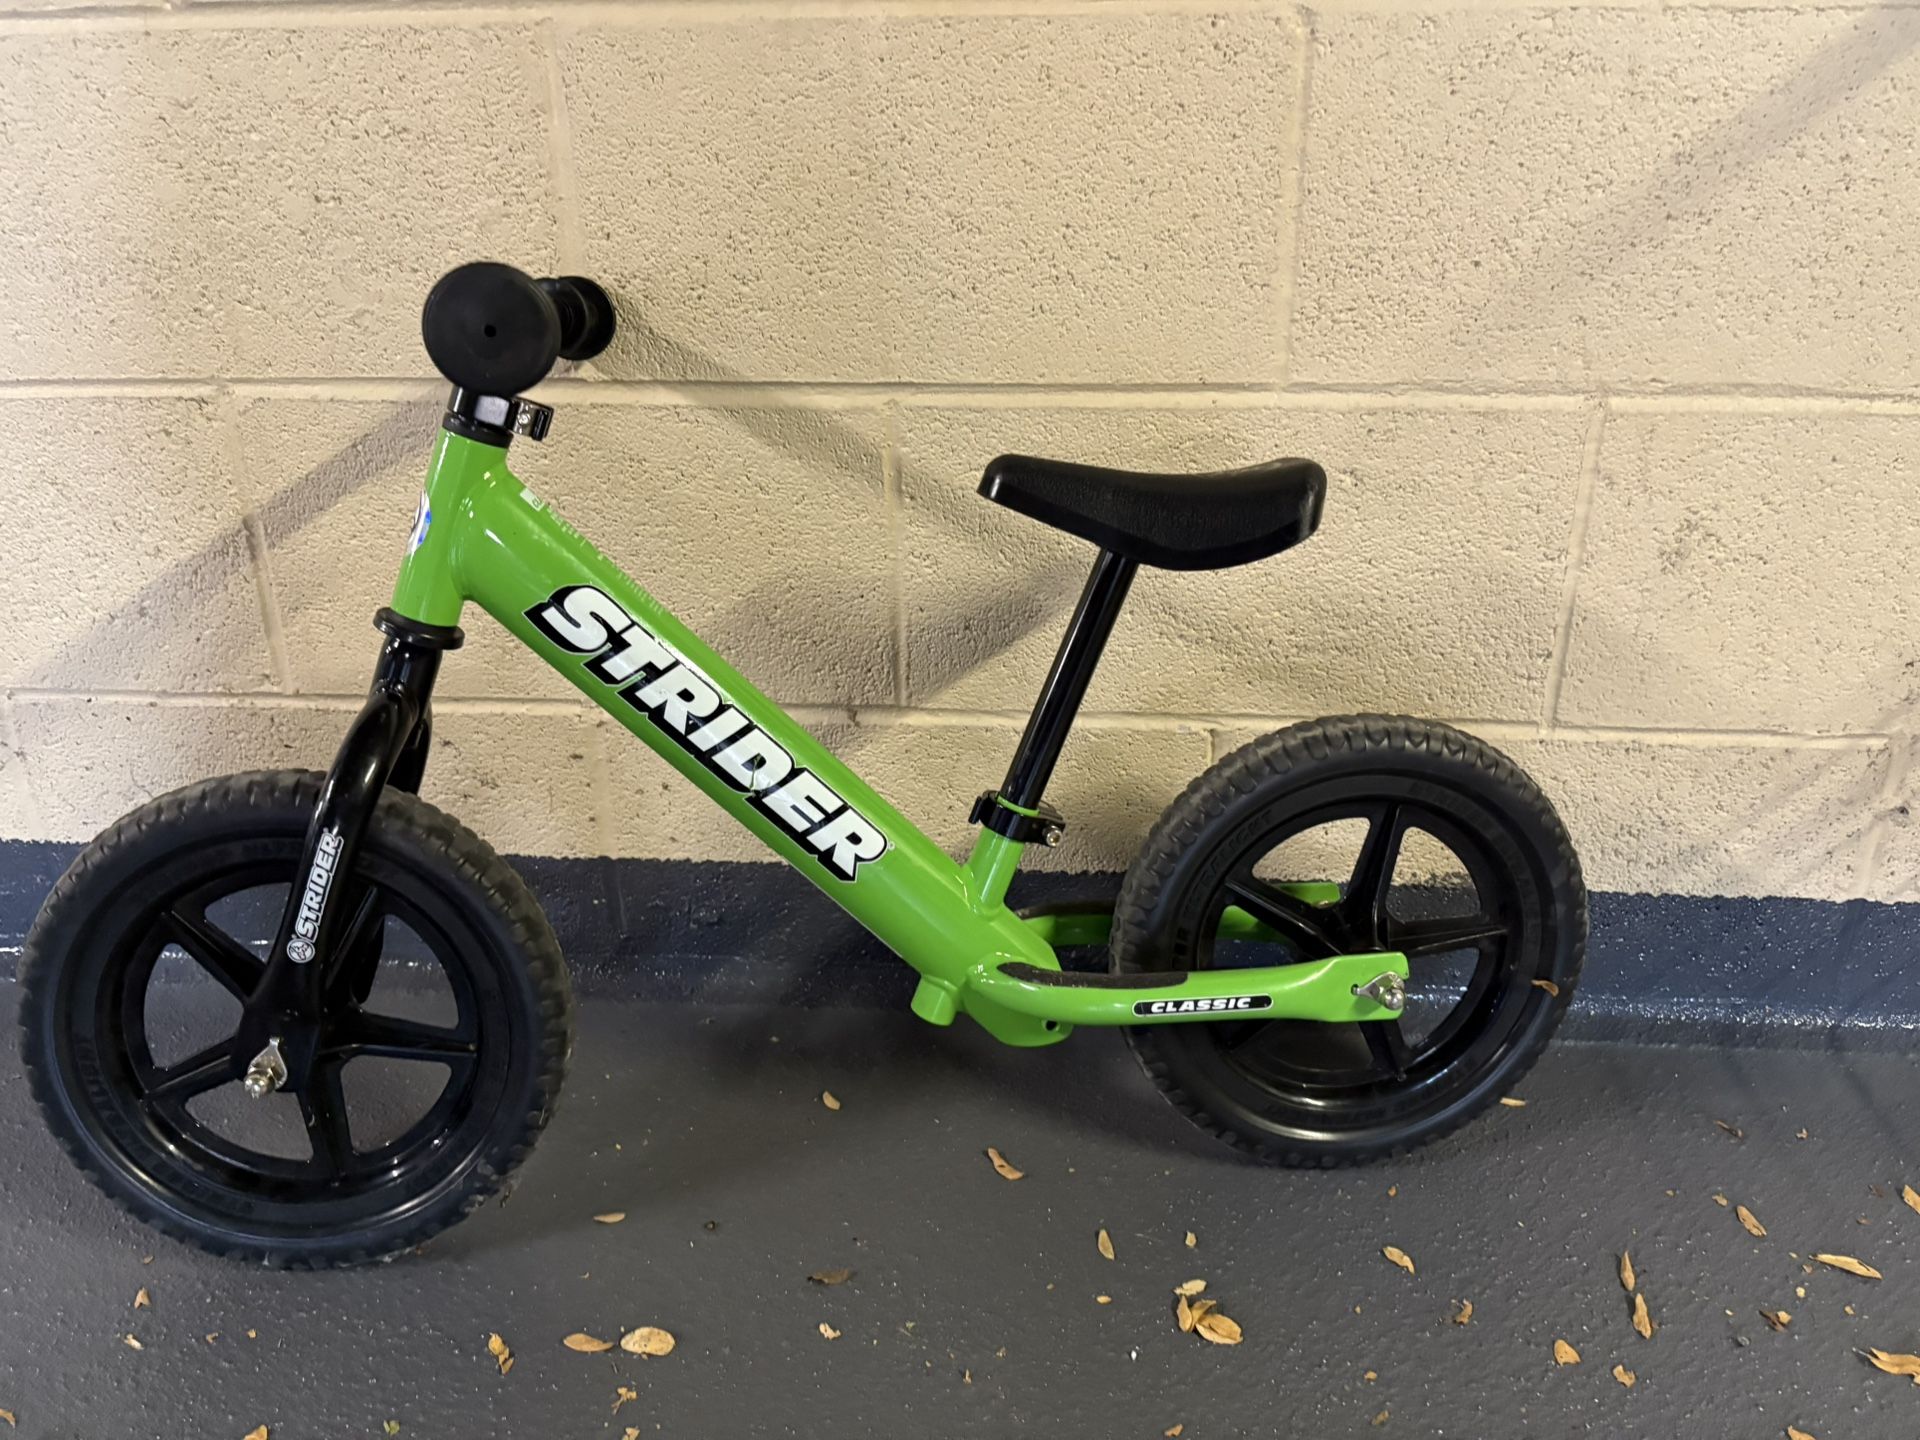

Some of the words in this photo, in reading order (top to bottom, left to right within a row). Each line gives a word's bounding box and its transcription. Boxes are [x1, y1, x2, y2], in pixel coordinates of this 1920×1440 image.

[526, 585, 888, 881] STRIDER
[297, 833, 342, 941] STRIDER
[1151, 997, 1251, 1014] CLASSIC
